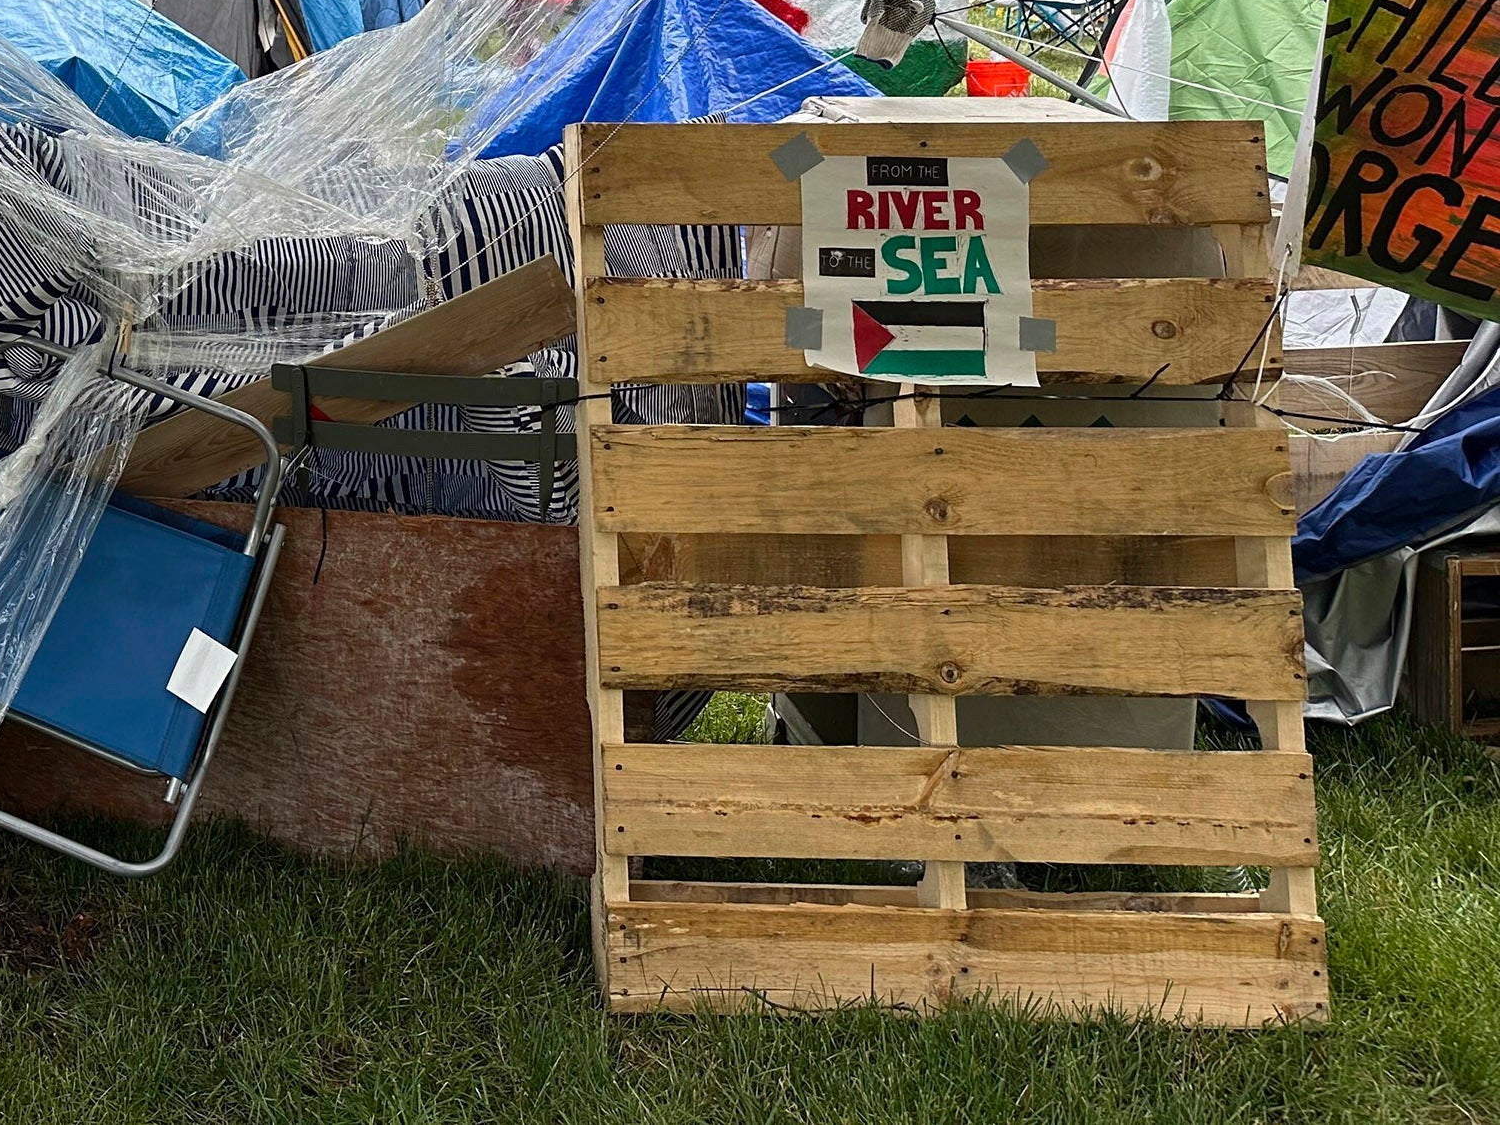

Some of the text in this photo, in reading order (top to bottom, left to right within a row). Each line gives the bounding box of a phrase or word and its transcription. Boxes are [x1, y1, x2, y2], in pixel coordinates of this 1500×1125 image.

[871, 164, 940, 179] FROM THE
[846, 189, 985, 231] RIVER
[820, 235, 1002, 295] TO THE SEA
